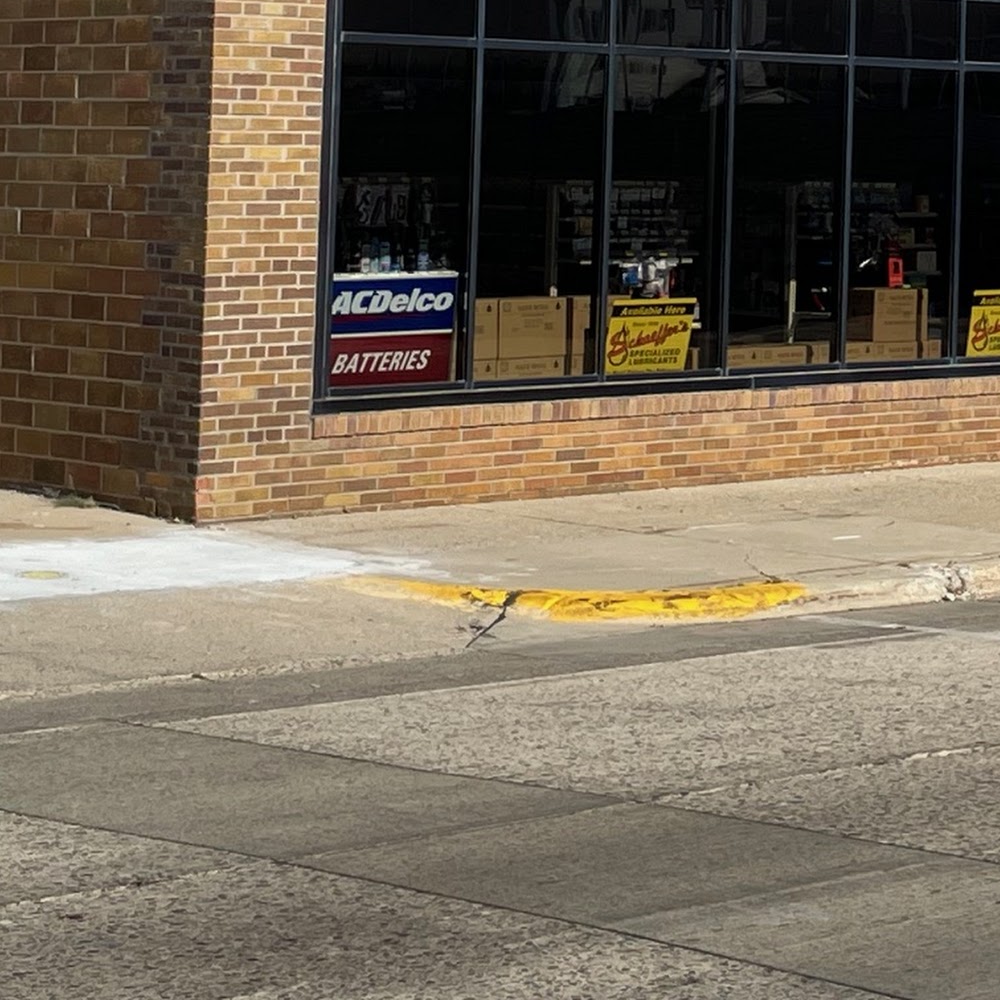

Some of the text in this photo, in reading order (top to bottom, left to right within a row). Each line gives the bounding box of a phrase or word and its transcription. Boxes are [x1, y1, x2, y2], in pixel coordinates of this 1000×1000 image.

[331, 287, 454, 315] ACDelco
[620, 305, 687, 316] Available Here
[629, 348, 681, 357] SPECIALIZED
[331, 349, 431, 375] BATTERIES
[628, 357, 678, 366] LUBRICANTS
